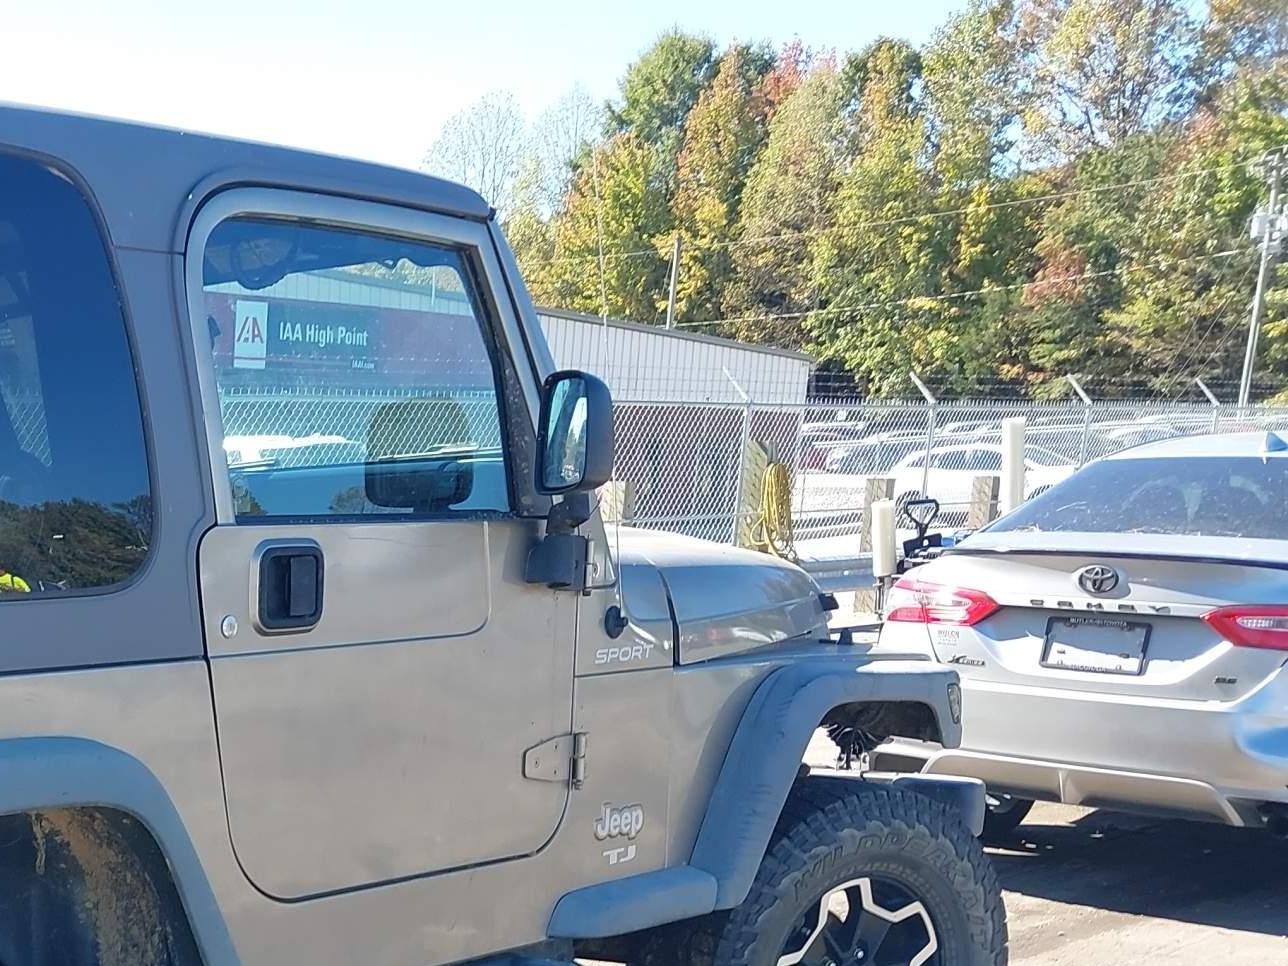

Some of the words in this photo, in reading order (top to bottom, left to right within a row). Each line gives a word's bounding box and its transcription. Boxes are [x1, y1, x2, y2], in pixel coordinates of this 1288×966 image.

[279, 321, 302, 342] IAA
[306, 323, 334, 347] High
[337, 325, 368, 347] Point
[594, 643, 654, 665] SPORT
[594, 802, 644, 841] Jeep
[603, 844, 637, 865] TJ
